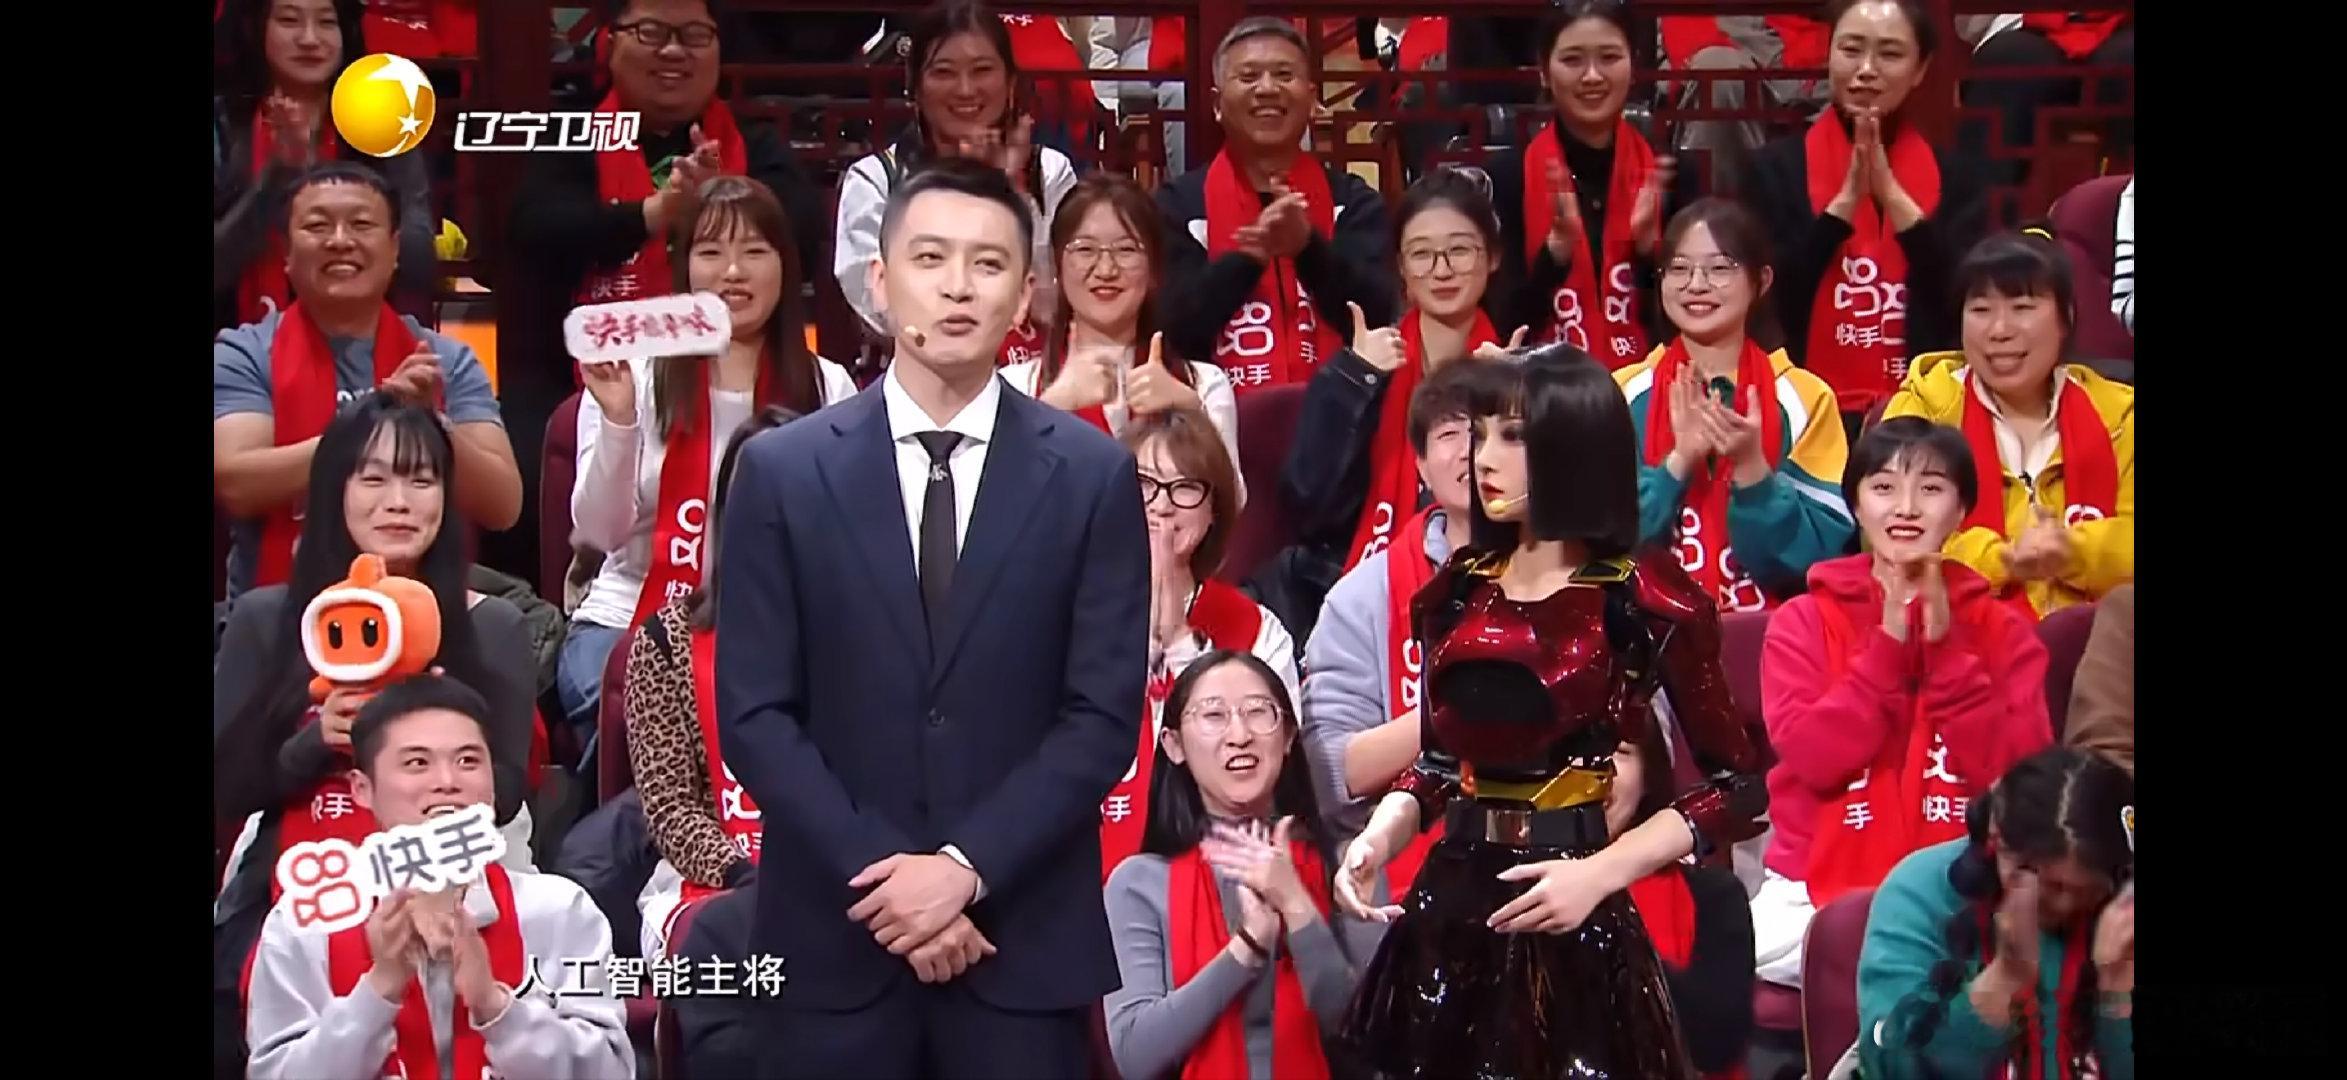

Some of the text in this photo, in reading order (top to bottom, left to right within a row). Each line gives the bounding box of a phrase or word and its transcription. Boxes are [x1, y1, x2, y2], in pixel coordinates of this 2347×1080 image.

[1836, 323, 1881, 348] 快手
[1007, 346, 1042, 365] 快
[1224, 363, 1272, 387] 快手
[1100, 794, 1132, 823] 手
[369, 814, 494, 891] 快手
